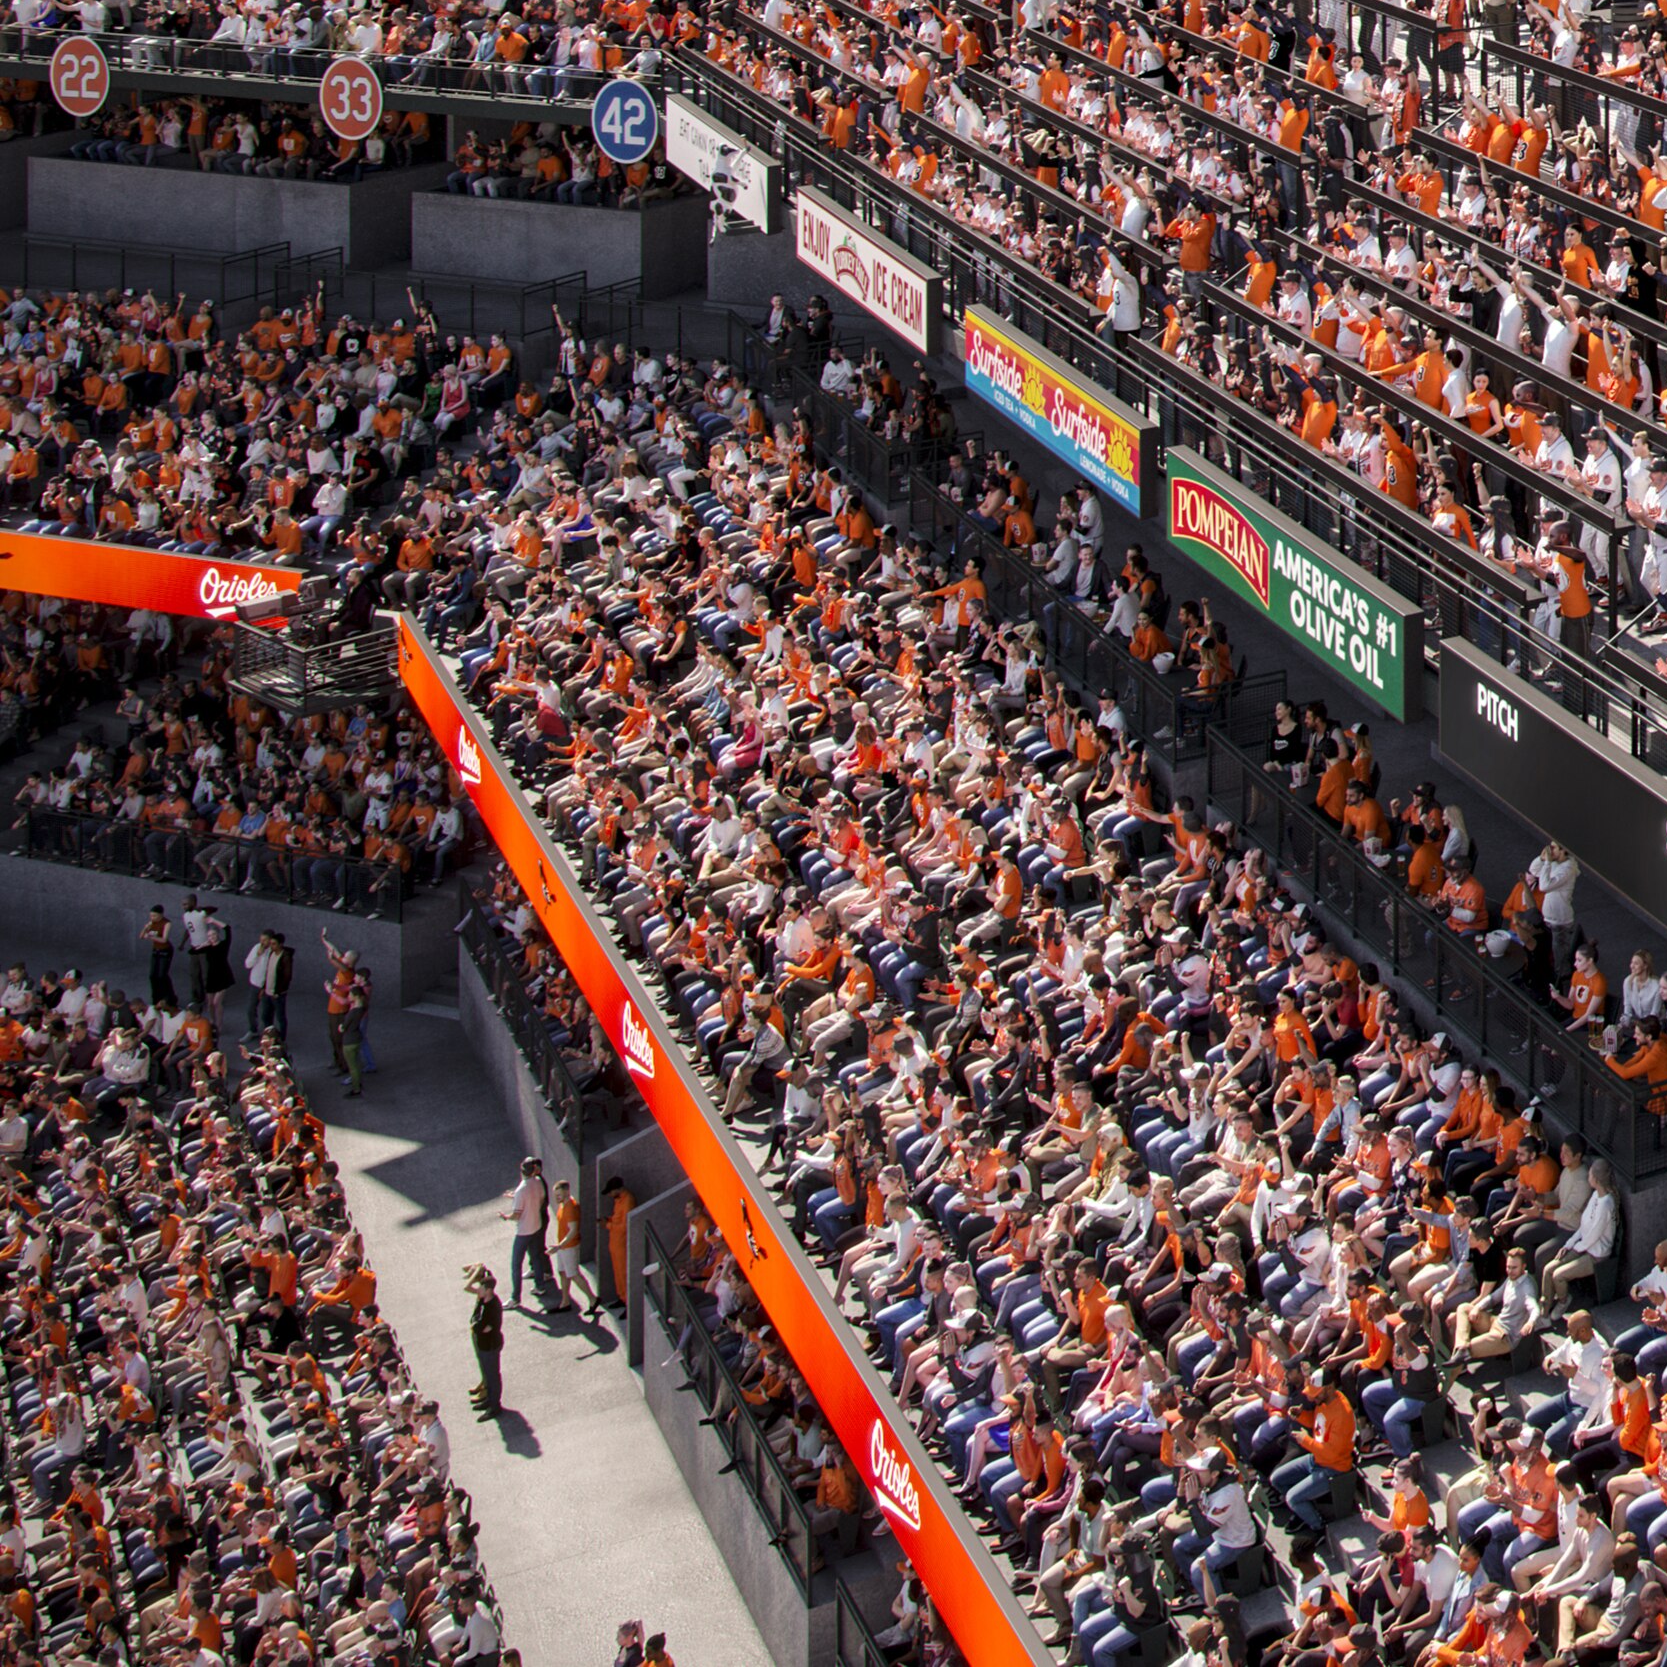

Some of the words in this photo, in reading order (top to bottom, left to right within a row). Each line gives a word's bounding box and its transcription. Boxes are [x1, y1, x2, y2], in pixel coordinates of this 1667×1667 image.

[60, 54, 99, 99] 22
[330, 75, 372, 122] 33
[601, 97, 646, 145] 42
[803, 209, 831, 265] ENJOY
[873, 258, 887, 309] ICE
[891, 272, 923, 335] CREAM
[970, 330, 1022, 400] Surfside
[1051, 387, 1107, 462] Surfside
[1019, 407, 1036, 429] VODKA
[1079, 453, 1106, 483] LEMONADE
[1111, 476, 1129, 501] VODKA
[1177, 485, 1265, 590] POMPEIAN
[200, 567, 278, 605] Orioles
[1273, 540, 1370, 636] AMERICA'S
[1376, 612, 1397, 657] #1
[1290, 590, 1346, 661] OLIVE
[1349, 634, 1384, 690] OIL
[1476, 681, 1519, 742] PITCH
[459, 724, 481, 778] Orioles
[623, 999, 655, 1070] Orioles
[871, 1418, 920, 1520] Orioles
